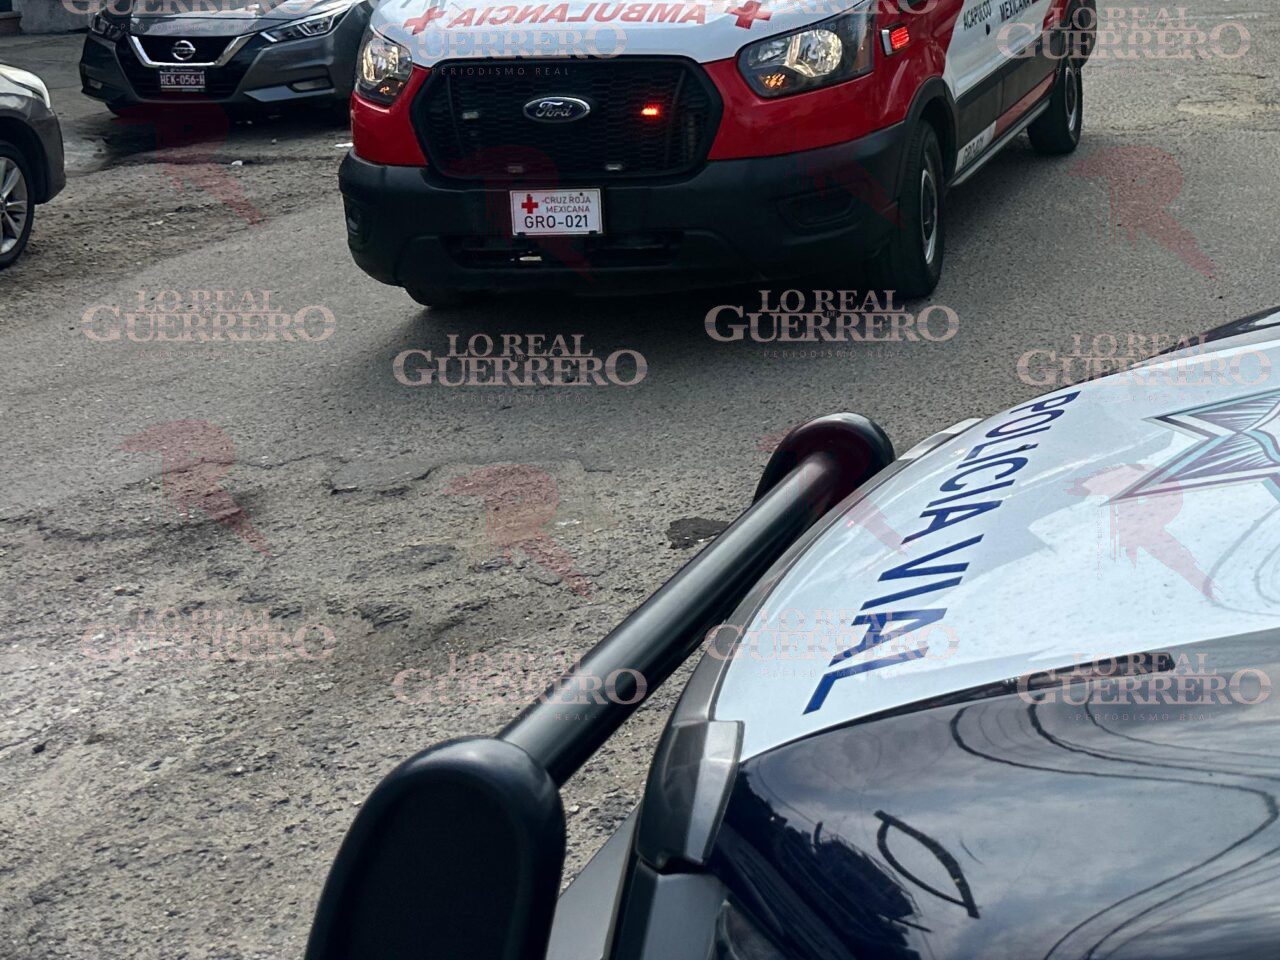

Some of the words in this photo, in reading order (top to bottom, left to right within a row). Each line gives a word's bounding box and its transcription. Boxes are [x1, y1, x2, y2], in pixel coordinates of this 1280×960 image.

[963, 0, 992, 31] ACAPULCO
[536, 101, 573, 118] Ford
[544, 196, 568, 205] CRUZ
[568, 195, 591, 205] ROJA
[546, 205, 590, 214] MEXICANA
[524, 214, 589, 229] GRO-021
[802, 533, 984, 715] VIAL
